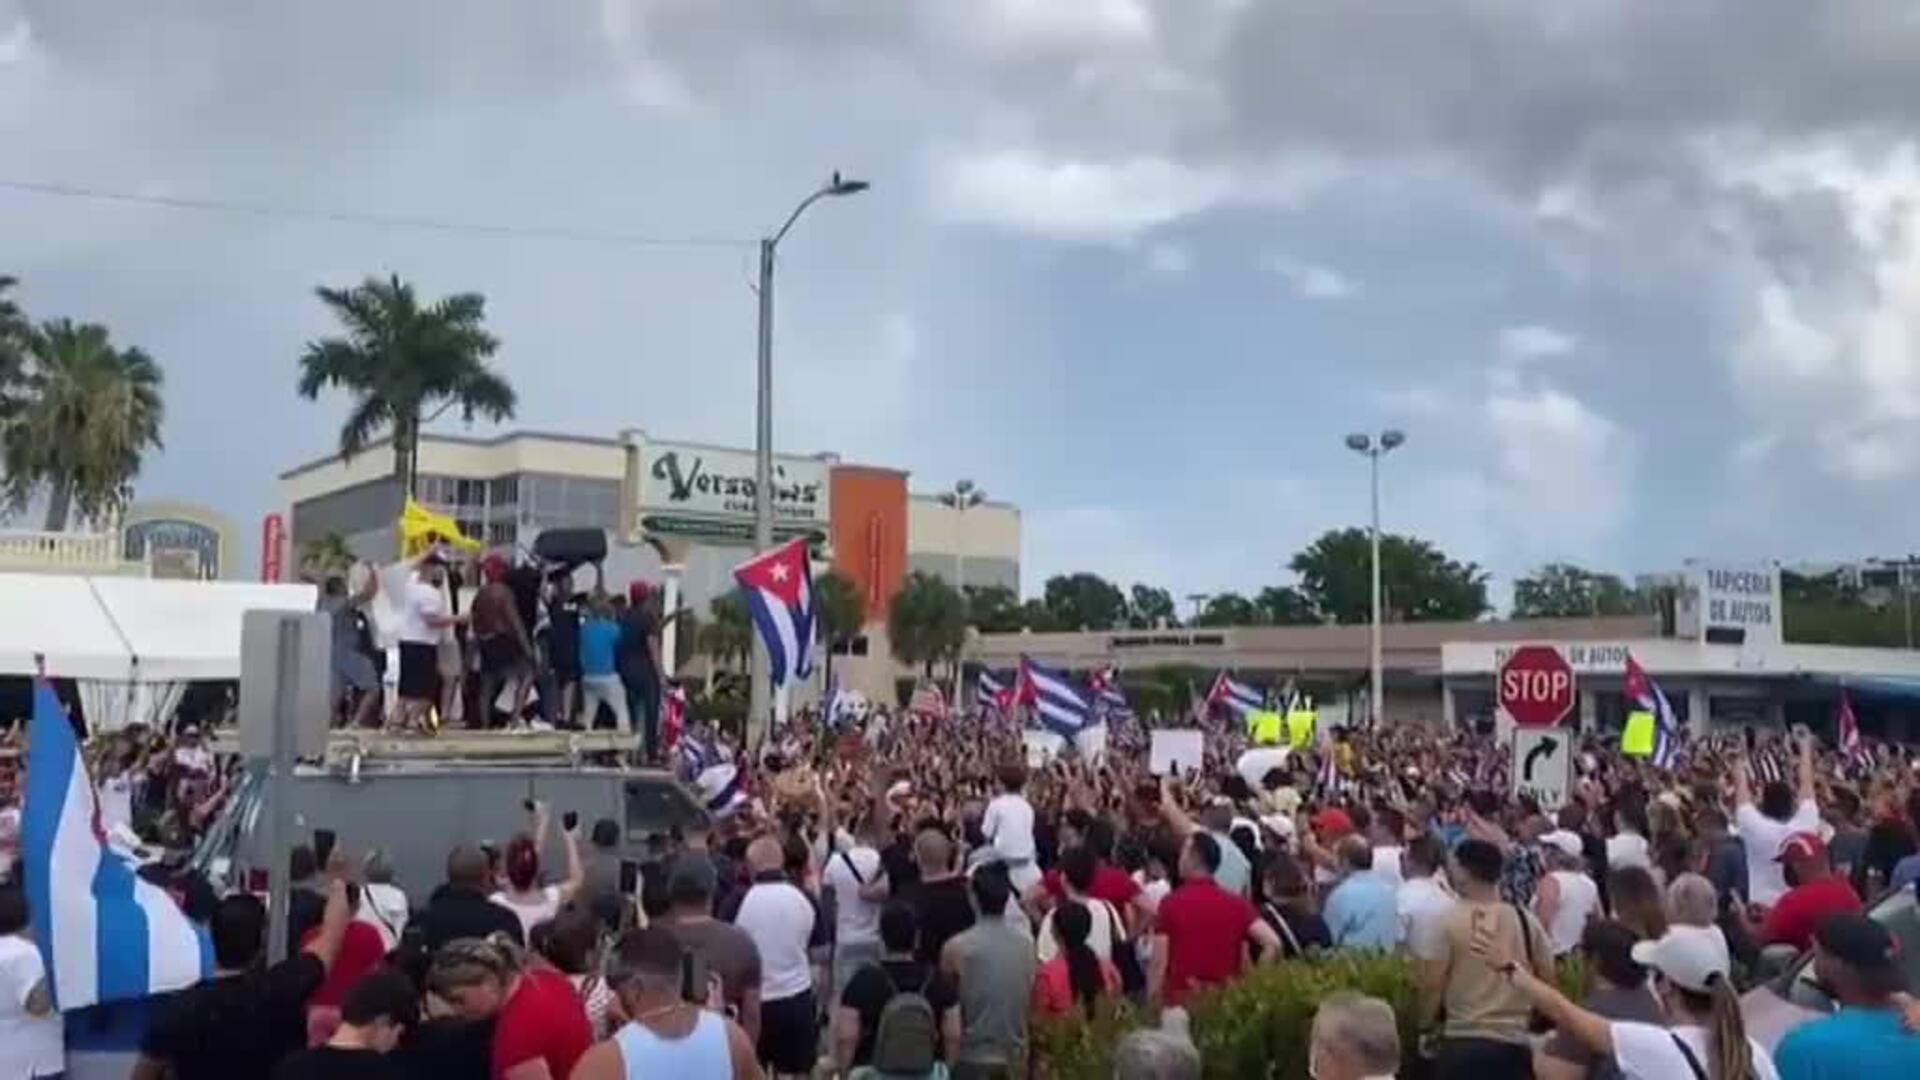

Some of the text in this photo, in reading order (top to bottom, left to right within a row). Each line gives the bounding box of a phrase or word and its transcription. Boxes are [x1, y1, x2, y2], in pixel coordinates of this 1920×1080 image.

[1710, 599, 1771, 624] DE AUTOS
[1503, 669, 1568, 700] STOP
